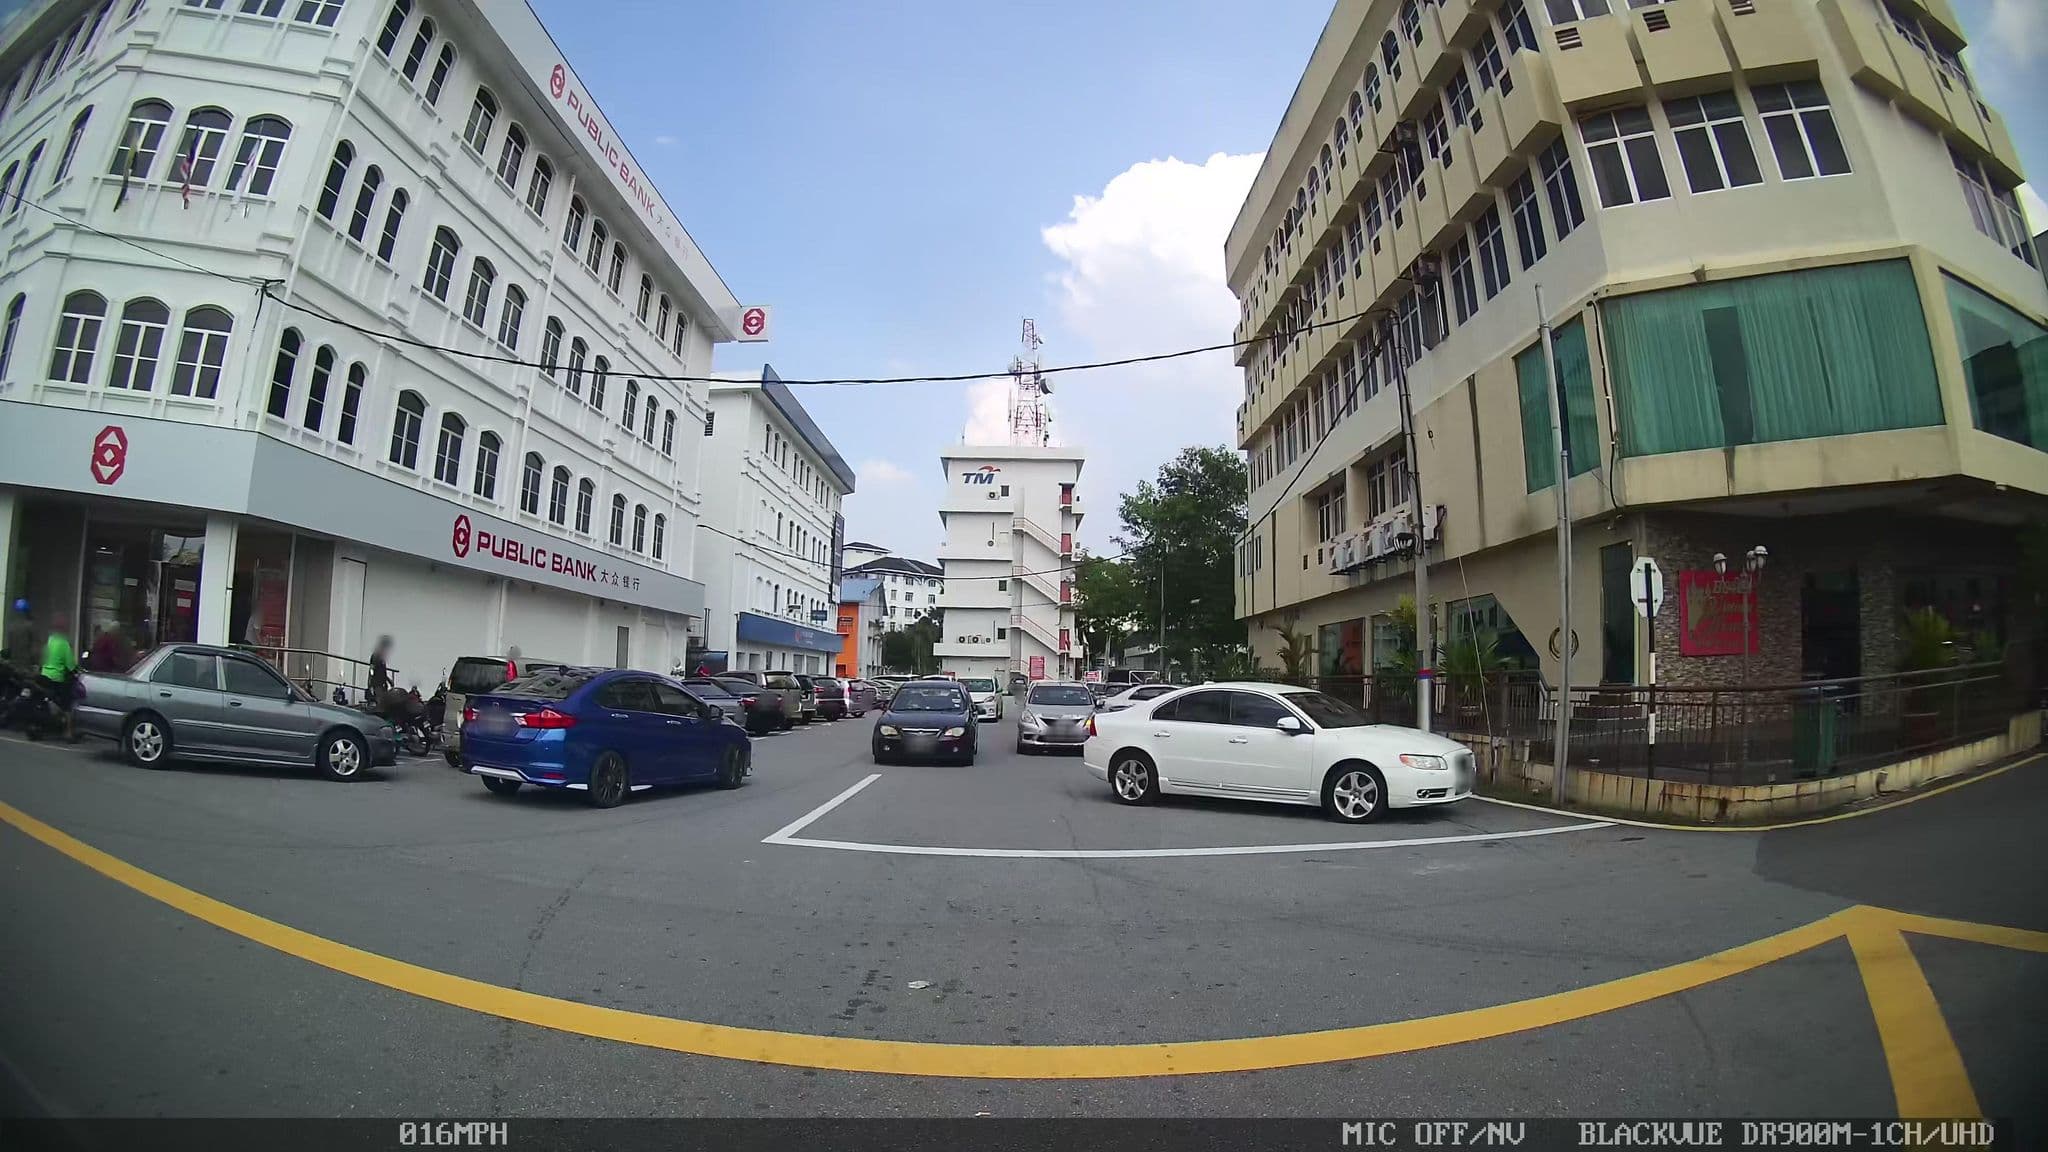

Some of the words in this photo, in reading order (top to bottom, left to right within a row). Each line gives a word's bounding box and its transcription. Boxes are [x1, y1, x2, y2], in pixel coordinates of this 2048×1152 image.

[567, 90, 619, 167] PUBLIC
[619, 160, 656, 218] BANK
[962, 472, 995, 484] TM
[476, 531, 546, 569] PUBLIC
[551, 553, 598, 582] BANK
